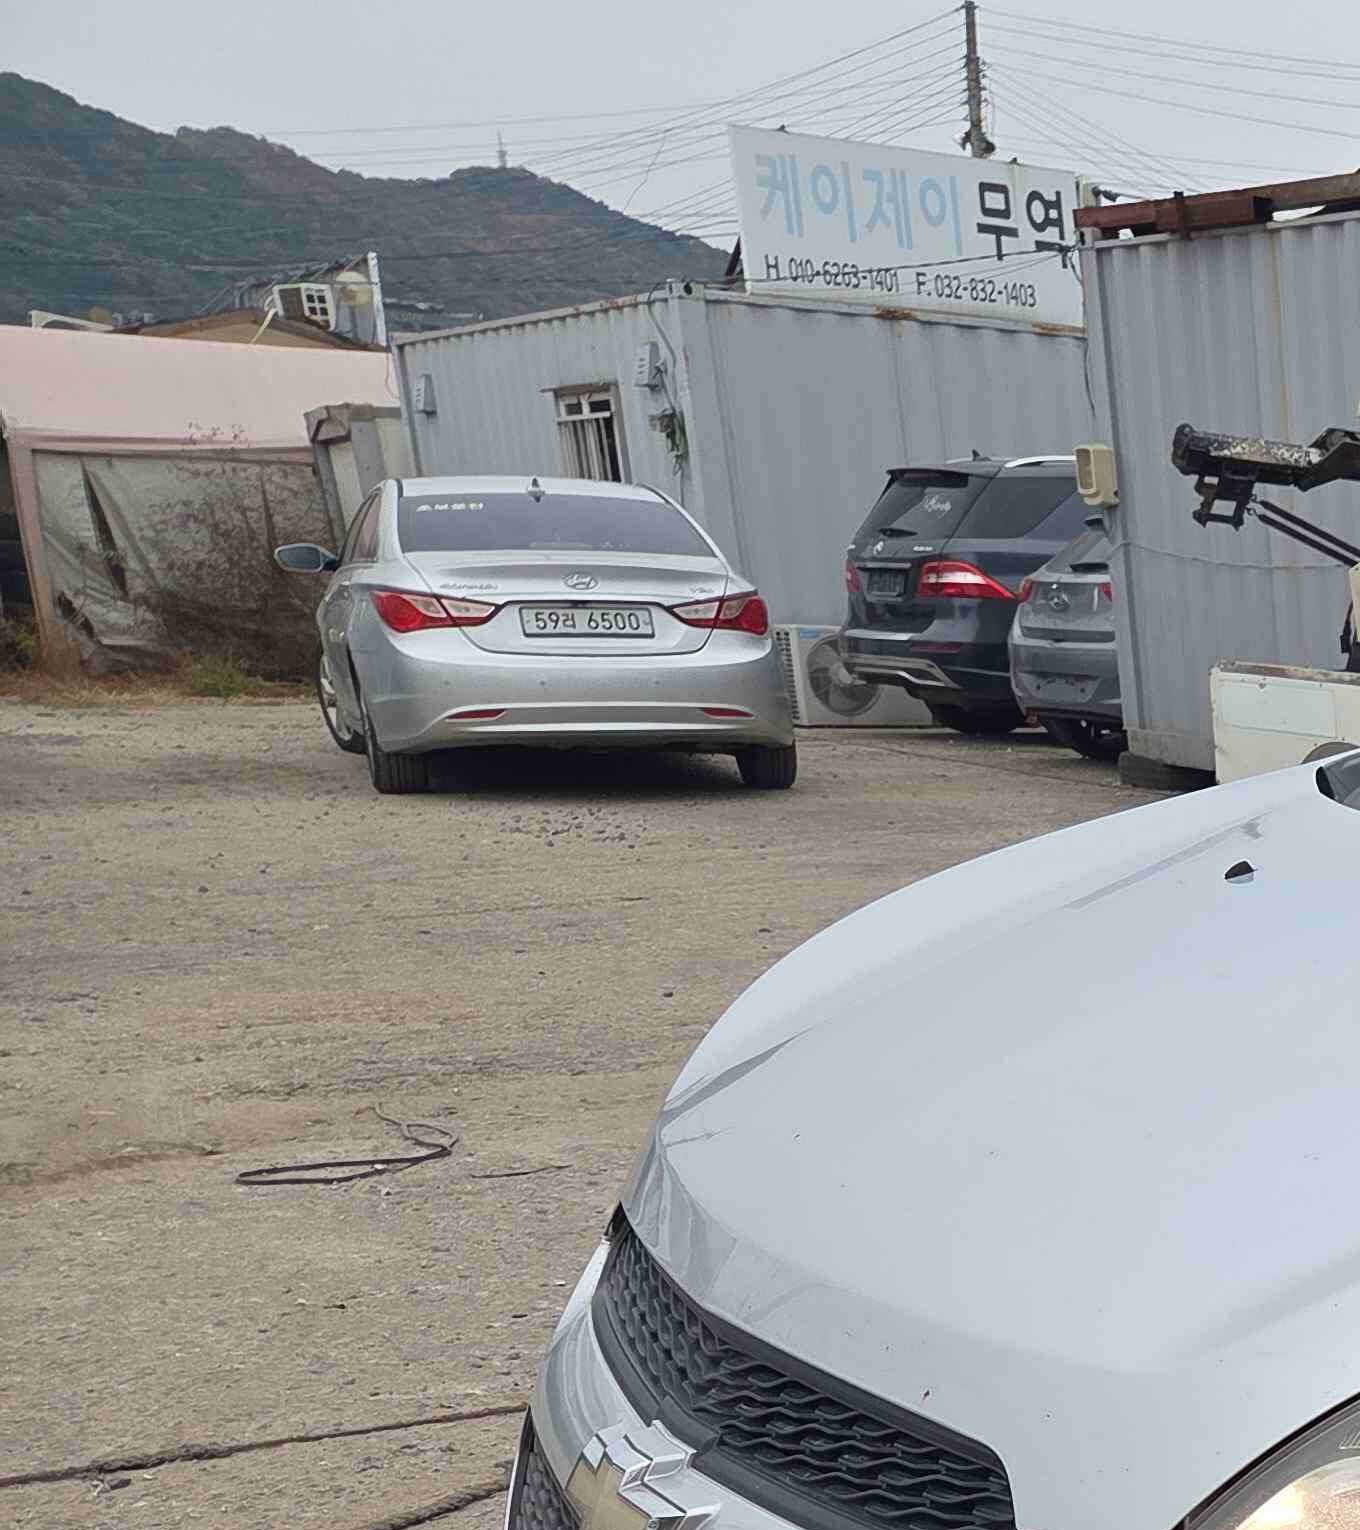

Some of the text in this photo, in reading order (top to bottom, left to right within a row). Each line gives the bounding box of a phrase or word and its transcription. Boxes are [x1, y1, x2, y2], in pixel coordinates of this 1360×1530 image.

[755, 152, 1068, 269] 케이제이 무역
[587, 611, 640, 630] 6500
